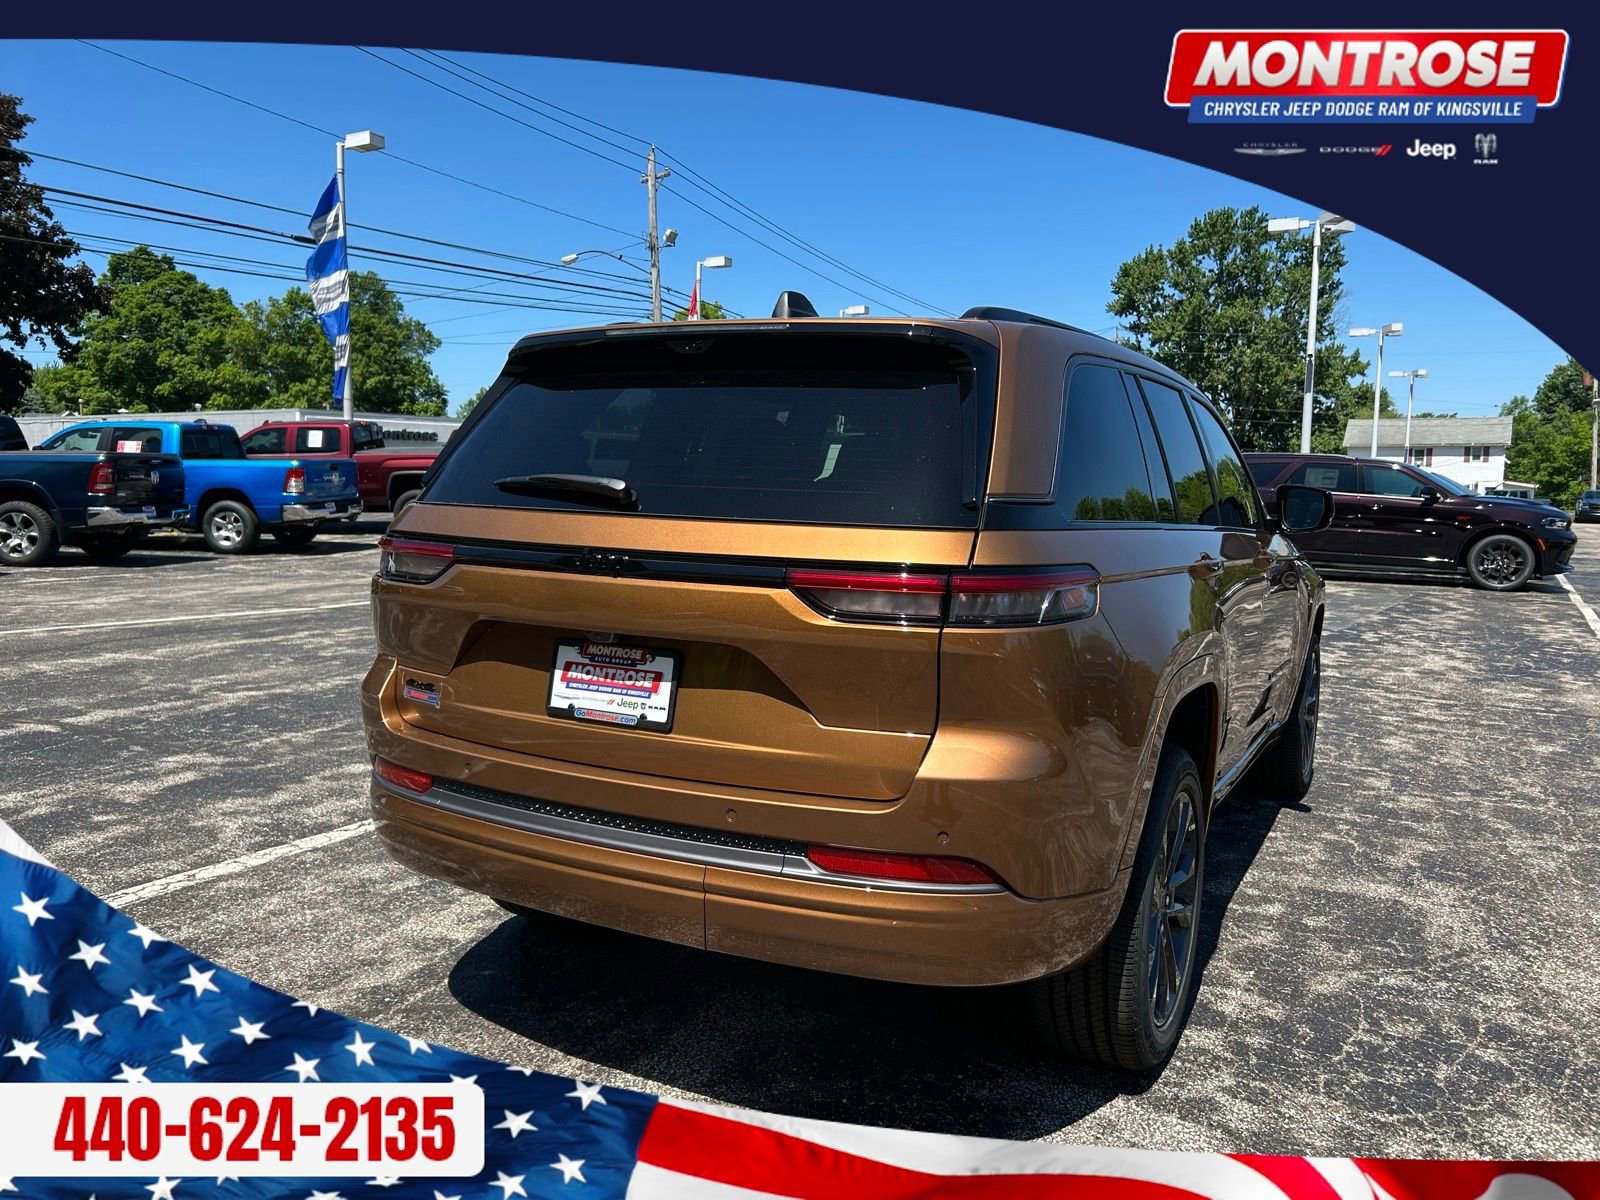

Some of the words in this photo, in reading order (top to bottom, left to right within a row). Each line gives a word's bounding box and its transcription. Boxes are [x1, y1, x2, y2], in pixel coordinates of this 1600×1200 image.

[383, 429, 438, 441] ontrose
[587, 645, 643, 659] MONTROSE
[567, 664, 656, 687] MONTROSE
[617, 698, 639, 710] Jeep
[575, 709, 637, 725] GoMontrose.com
